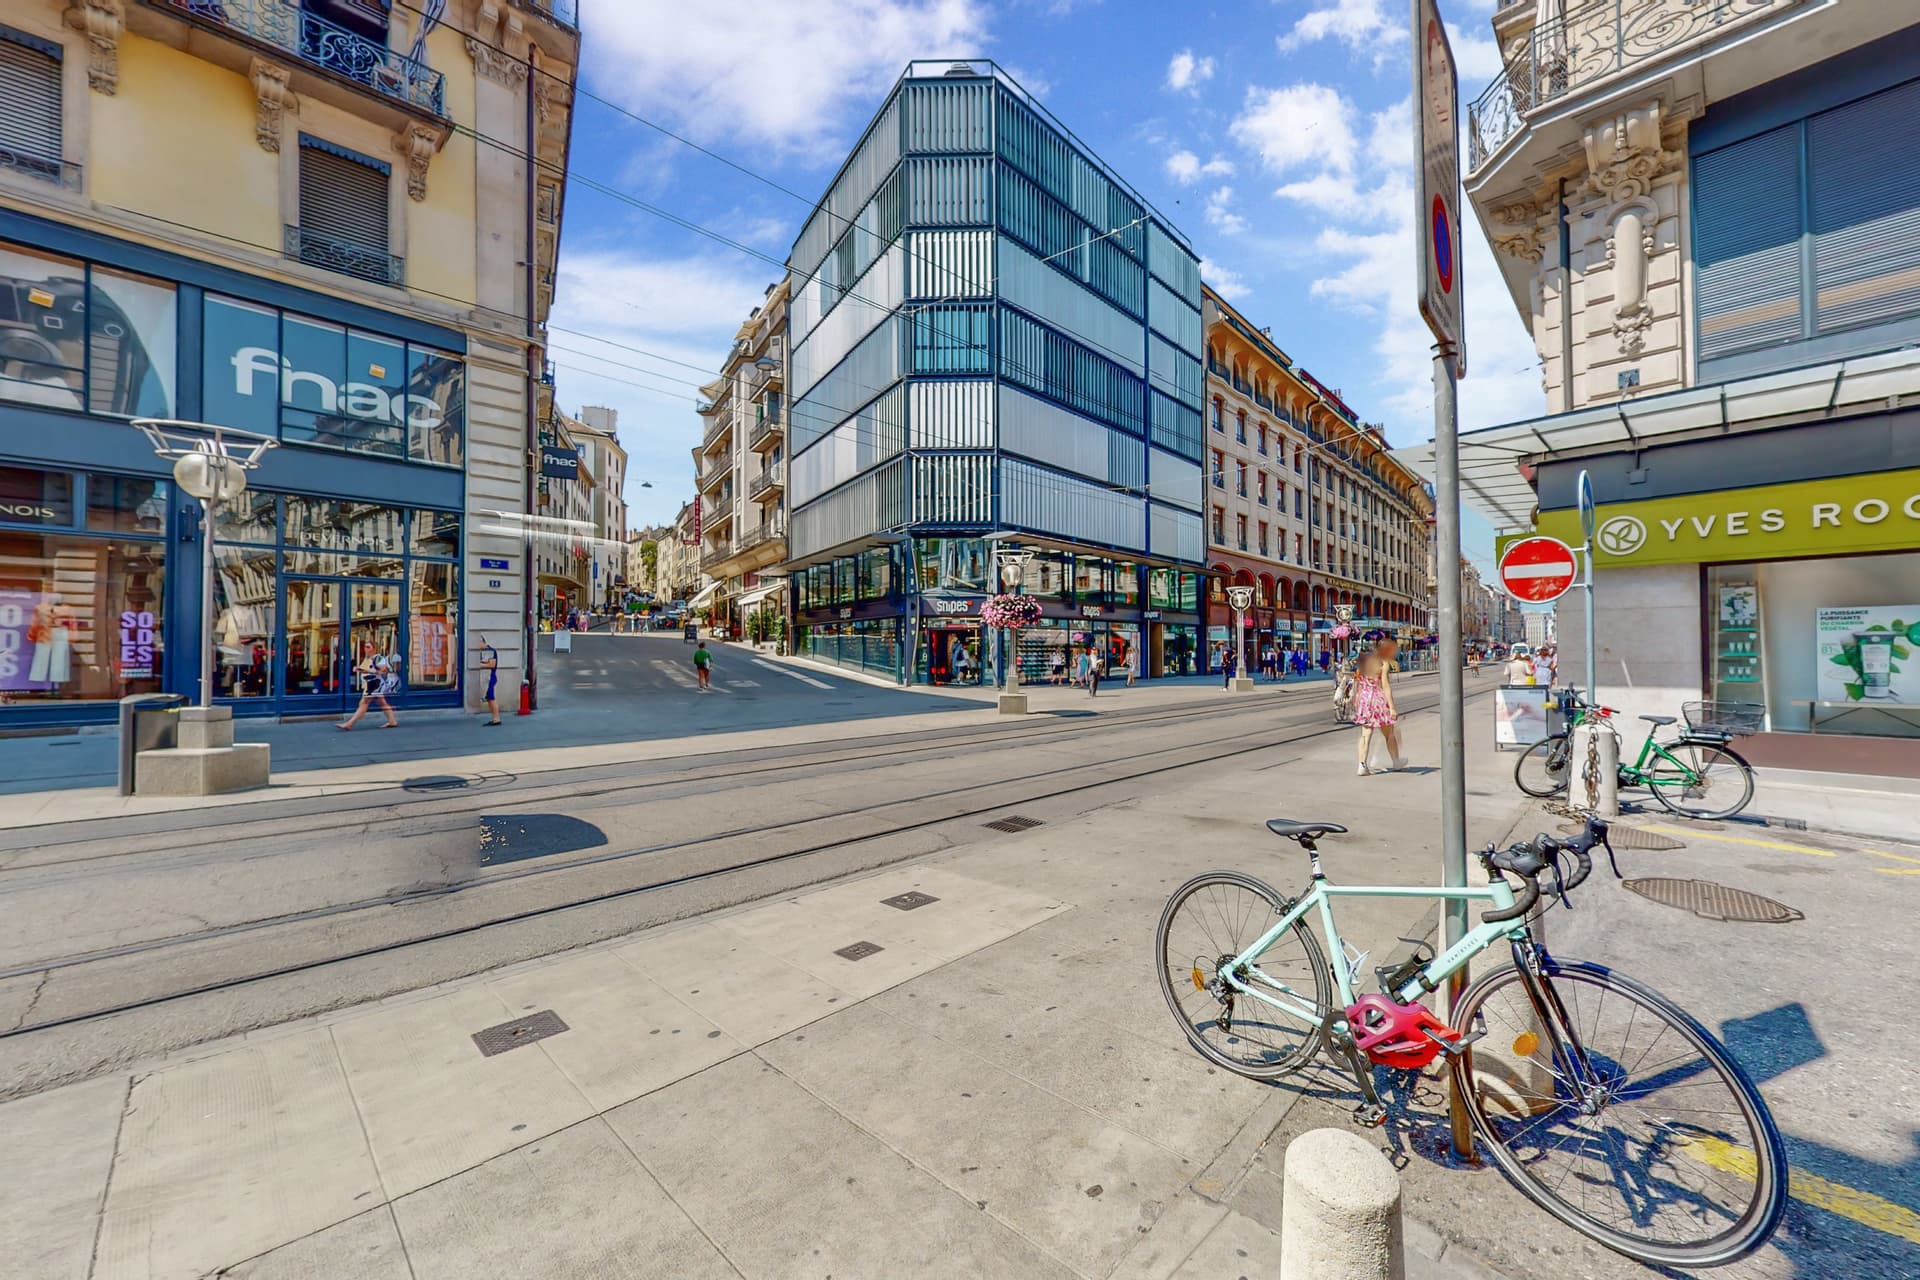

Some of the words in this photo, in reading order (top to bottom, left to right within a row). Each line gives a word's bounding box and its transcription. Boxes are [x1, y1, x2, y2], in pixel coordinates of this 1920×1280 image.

[230, 347, 442, 428] fnac
[543, 453, 577, 467] fnac
[1660, 509, 1786, 541] YVES
[937, 600, 968, 614] snipes
[120, 610, 154, 628] SO
[120, 629, 153, 645] LD
[120, 646, 153, 663] ES
